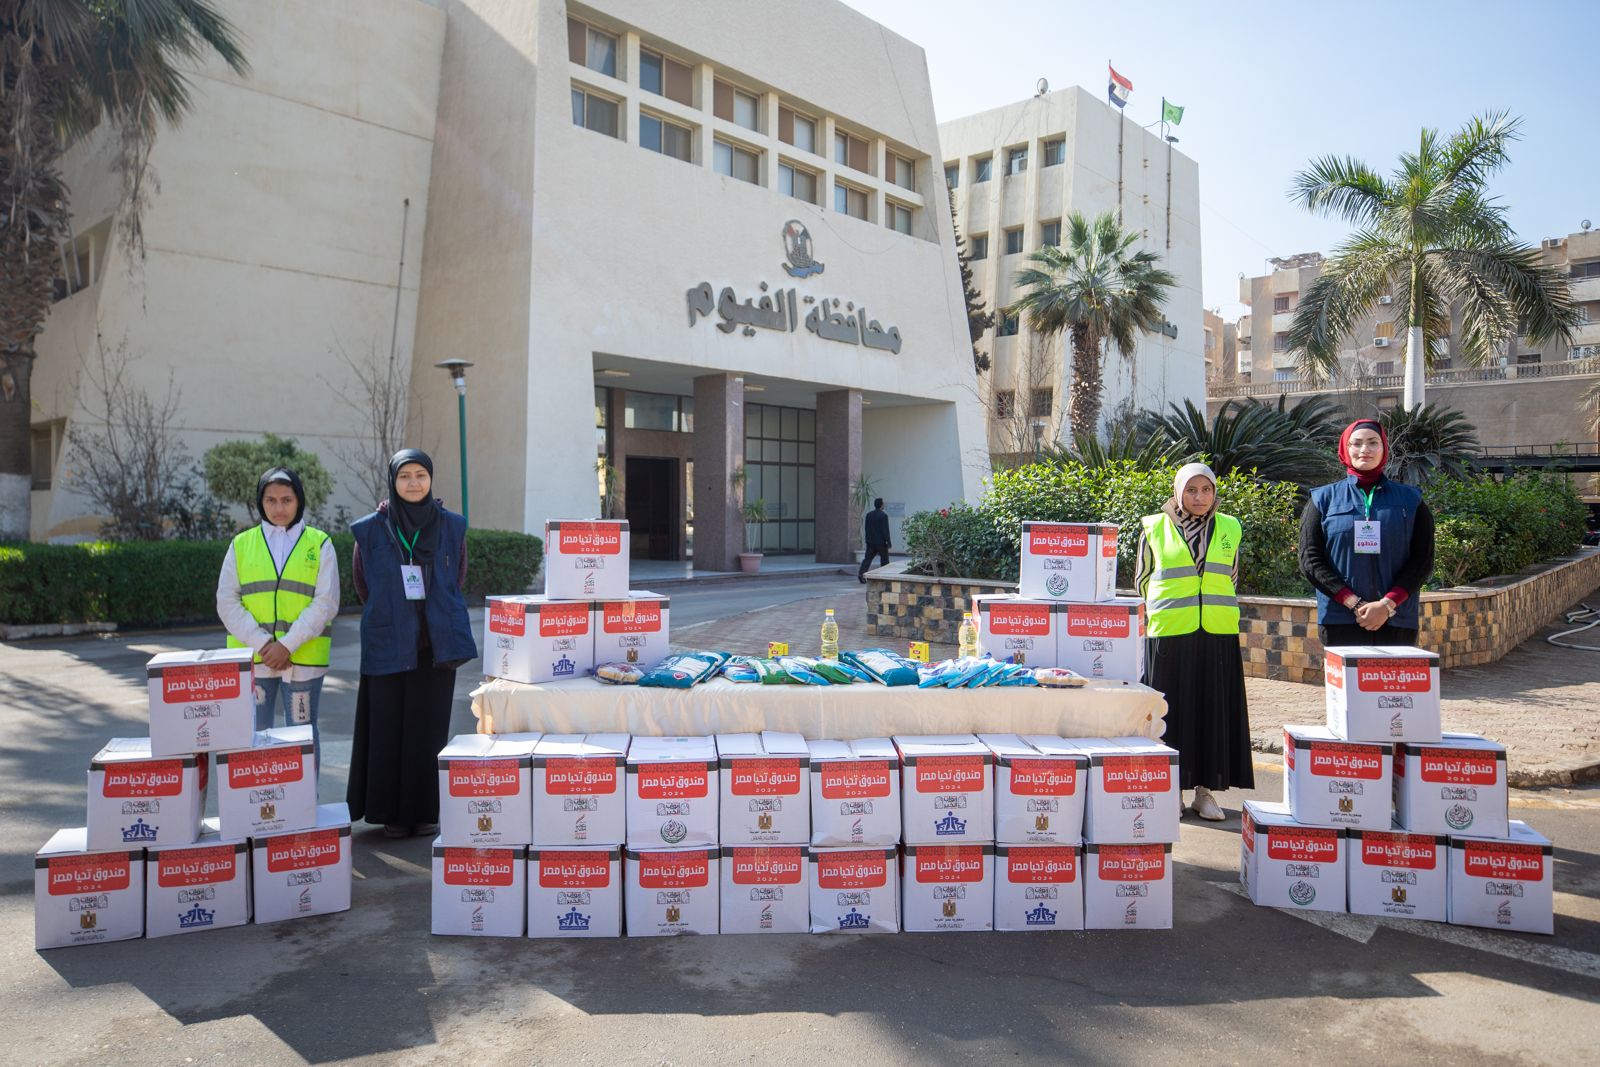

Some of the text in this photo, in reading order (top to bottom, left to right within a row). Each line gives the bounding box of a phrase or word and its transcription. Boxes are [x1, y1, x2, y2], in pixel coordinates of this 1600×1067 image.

[686, 281, 902, 355] محافظة الفيوم
[563, 535, 618, 546] صندوق تحيا مصر
[1032, 536, 1086, 548] صندوق تحيا مصر
[542, 615, 587, 628] صندوق تحيا مصر
[607, 614, 658, 624] صندوق تحيا مصر
[993, 616, 1047, 627] صندوق تحيا مصر
[1070, 617, 1126, 629] صندوق تحيا مصر
[1361, 670, 1427, 683] صندوق تحيا مصر
[167, 677, 236, 693] صندوق تحيا مصر
[1314, 756, 1379, 769] صندوق تحيا مصر
[1425, 761, 1493, 775] صندوق تحيا مصر
[233, 760, 299, 779] صندوق تحيا مصر
[108, 773, 179, 787] صندوق تحيا مصر
[453, 774, 516, 786] صندوق تحيا مصر
[549, 772, 613, 784] صندوق تحيا مصر
[735, 773, 797, 785] صندوق تحيا مصر
[825, 775, 887, 788] صندوق تحيا مصر
[920, 770, 981, 782] صندوق تحيا مصر
[1014, 773, 1073, 786] صندوق تحيا مصر
[1107, 771, 1168, 782] صندوق تحيا مصر
[642, 776, 704, 789] صندوق تحيا مصر
[1272, 840, 1334, 852] صندوق تحيا مصر
[1366, 845, 1432, 859] صندوق تحيا مصر
[272, 844, 336, 862] صندوق تحيا مصر
[162, 860, 232, 877] صندوق تحيا مصر
[447, 863, 510, 875] صندوق تحيا مصر
[736, 862, 798, 874] صندوق تحيا مصر
[920, 861, 980, 872] صندوق تحيا مصر
[1012, 862, 1072, 873] صندوق تحيا مصر
[1102, 860, 1162, 872] صندوق تحيا مصر
[1469, 856, 1540, 870] صندوق تحيا مصر
[53, 867, 126, 884] صندوق تحيا مصر
[543, 866, 606, 878] صندوق تحيا مصر
[643, 866, 705, 878] صندوق تحيا مصر
[822, 866, 883, 879] صندوق تحيا مصر
